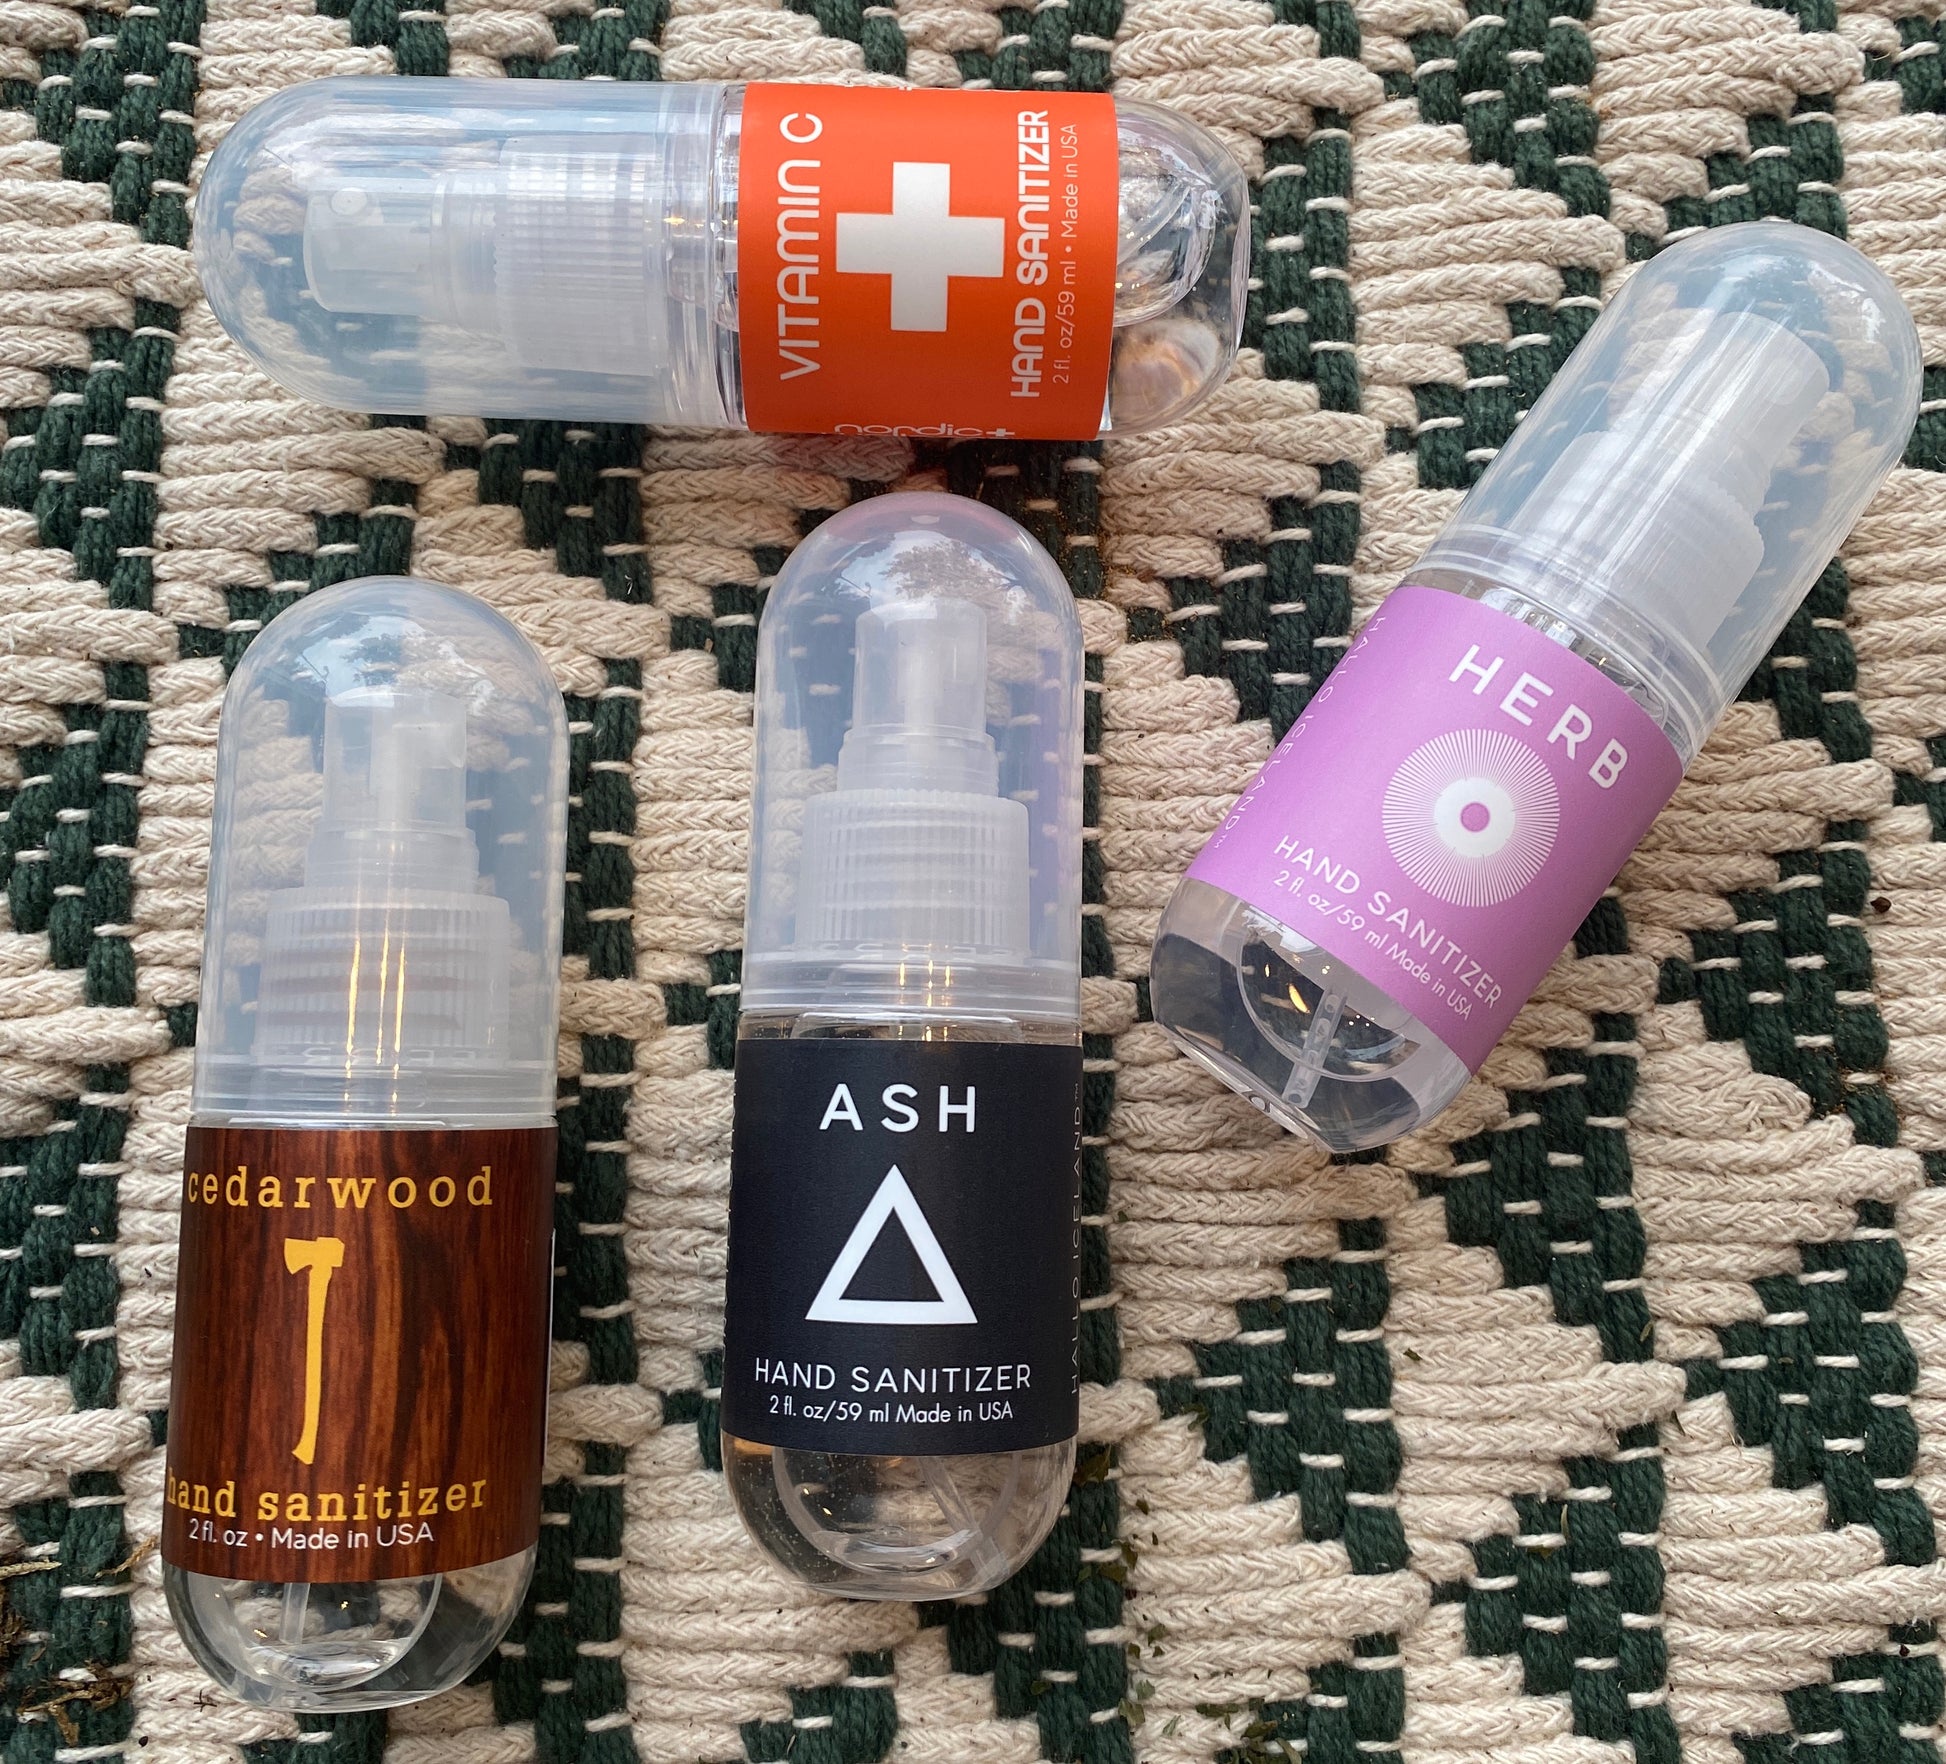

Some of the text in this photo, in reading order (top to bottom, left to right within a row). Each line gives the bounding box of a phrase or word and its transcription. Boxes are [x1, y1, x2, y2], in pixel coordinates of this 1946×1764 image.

[779, 112, 823, 144] C
[1010, 110, 1050, 398] HAND SANITIZER
[1053, 124, 1079, 384] 2 fl. oz/59 ml Made in USA
[1317, 617, 1387, 703] HALLO
[1448, 644, 1629, 789] HERB
[1273, 834, 1502, 1009] HAND SANITIZER
[1273, 870, 1473, 1021] 2 fl. oz/59 ml Made in USA
[818, 1082, 977, 1133] ASH
[187, 1164, 494, 1209] cedarwood
[755, 1357, 1032, 1394] HAND SANITIZER
[769, 1394, 1014, 1424] 2 fl. oz/59 ml Made in USA
[166, 1466, 488, 1523] hand sanitizer
[188, 1517, 435, 1550] 2 fl. oz Made in USA
